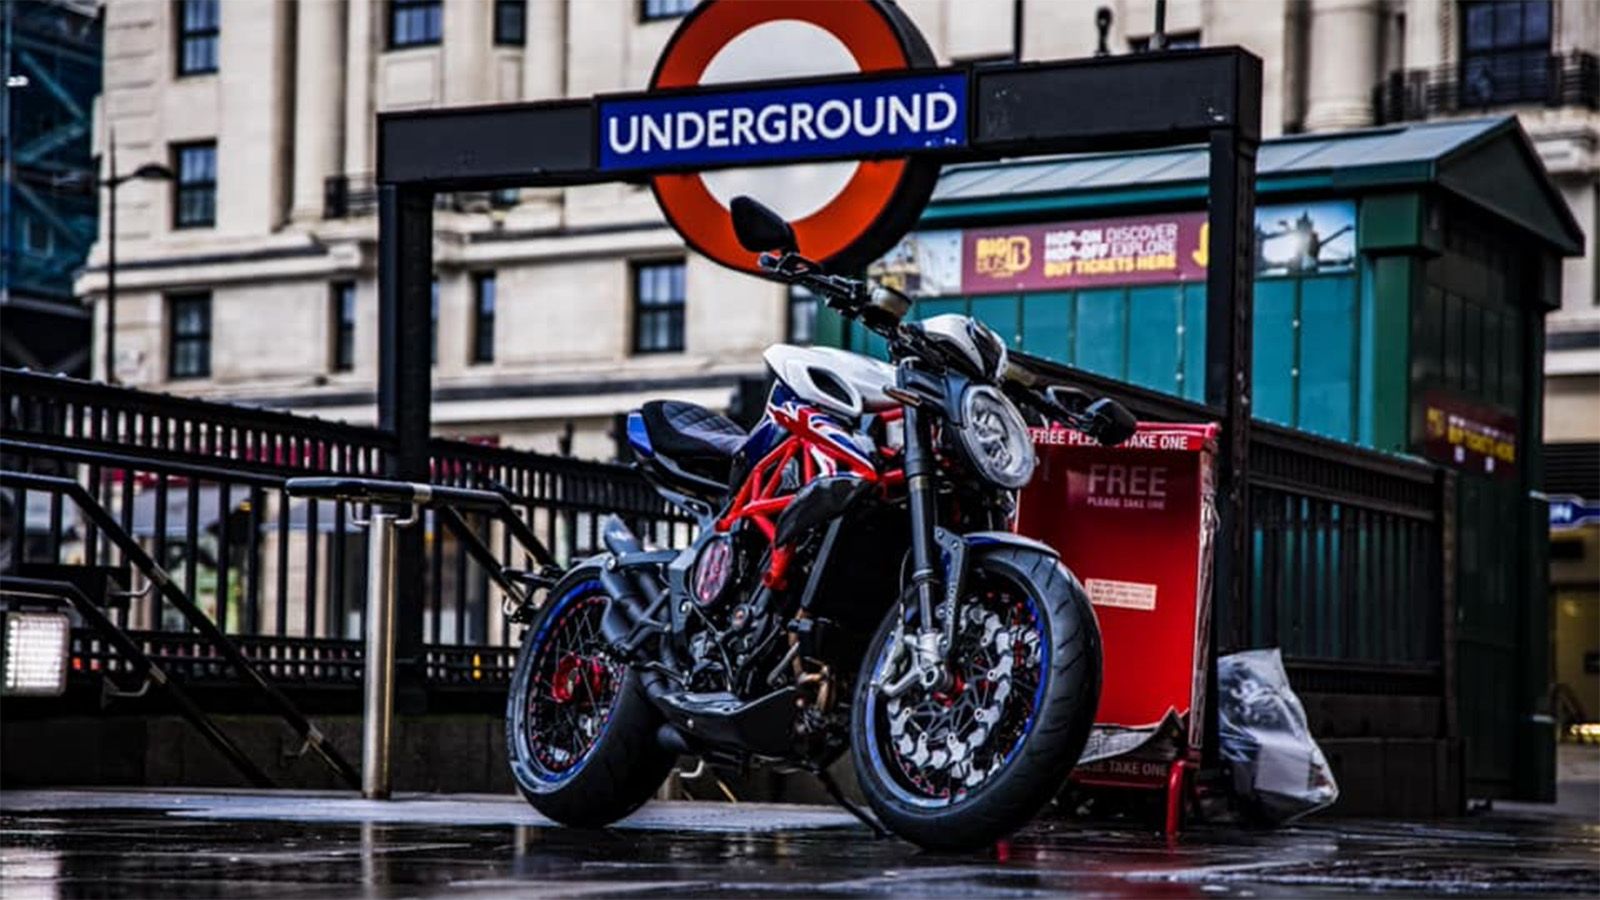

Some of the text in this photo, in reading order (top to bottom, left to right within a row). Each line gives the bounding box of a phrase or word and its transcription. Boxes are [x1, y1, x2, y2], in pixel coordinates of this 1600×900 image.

[608, 91, 958, 154] UNDERGROUND
[1045, 223, 1179, 246] HOP-ON DISCOVER
[1045, 239, 1177, 261] HOP-OFF EXPLORE
[1044, 252, 1176, 278] BUY TICKETS HERE
[1032, 430, 1066, 445] FREE
[1160, 436, 1189, 450] ONE
[1088, 464, 1168, 497] FREE
[1087, 496, 1165, 510] PLEASE TAKE ONE
[1109, 760, 1140, 775] TAKE
[1142, 762, 1168, 777] ONE
